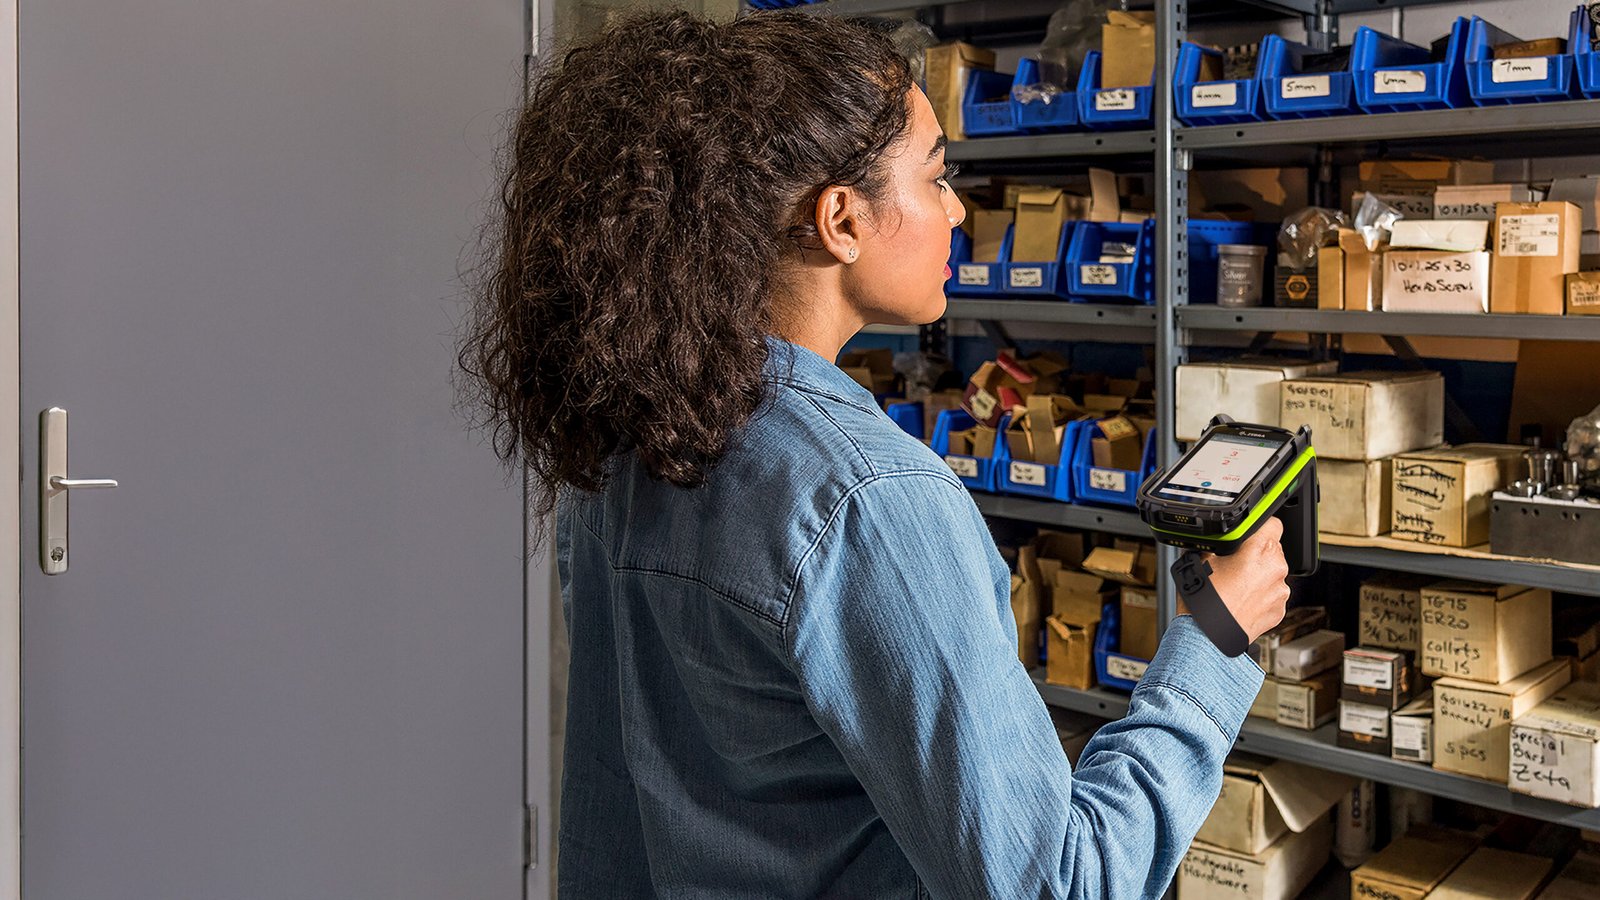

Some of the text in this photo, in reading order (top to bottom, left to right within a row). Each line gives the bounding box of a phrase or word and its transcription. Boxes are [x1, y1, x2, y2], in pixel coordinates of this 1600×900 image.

[1500, 61, 1532, 72] 7mm
[1286, 80, 1317, 92] 5mm
[1512, 726, 1565, 755] Special
